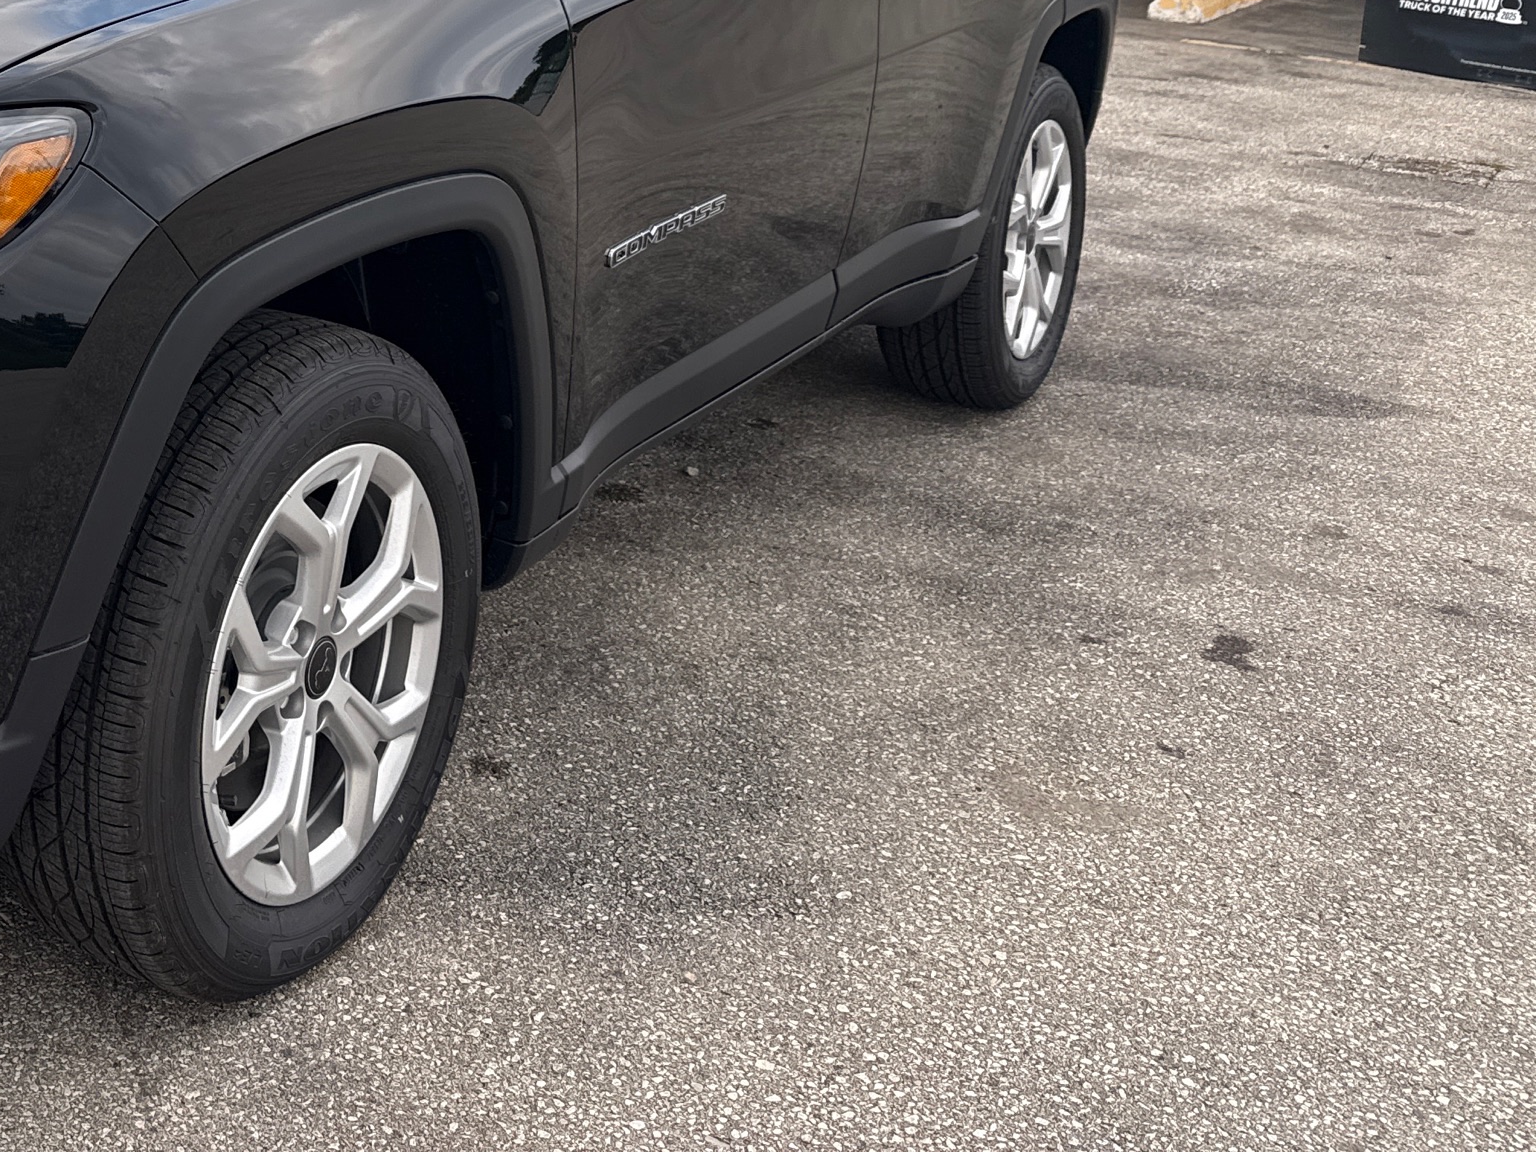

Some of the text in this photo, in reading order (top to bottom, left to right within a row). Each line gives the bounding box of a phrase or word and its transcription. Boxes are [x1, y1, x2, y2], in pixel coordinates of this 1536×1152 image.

[1399, 0, 1496, 21] TRUCK OF THE YEAR
[1500, 11, 1518, 22] 2025
[606, 194, 727, 268] COMPASS
